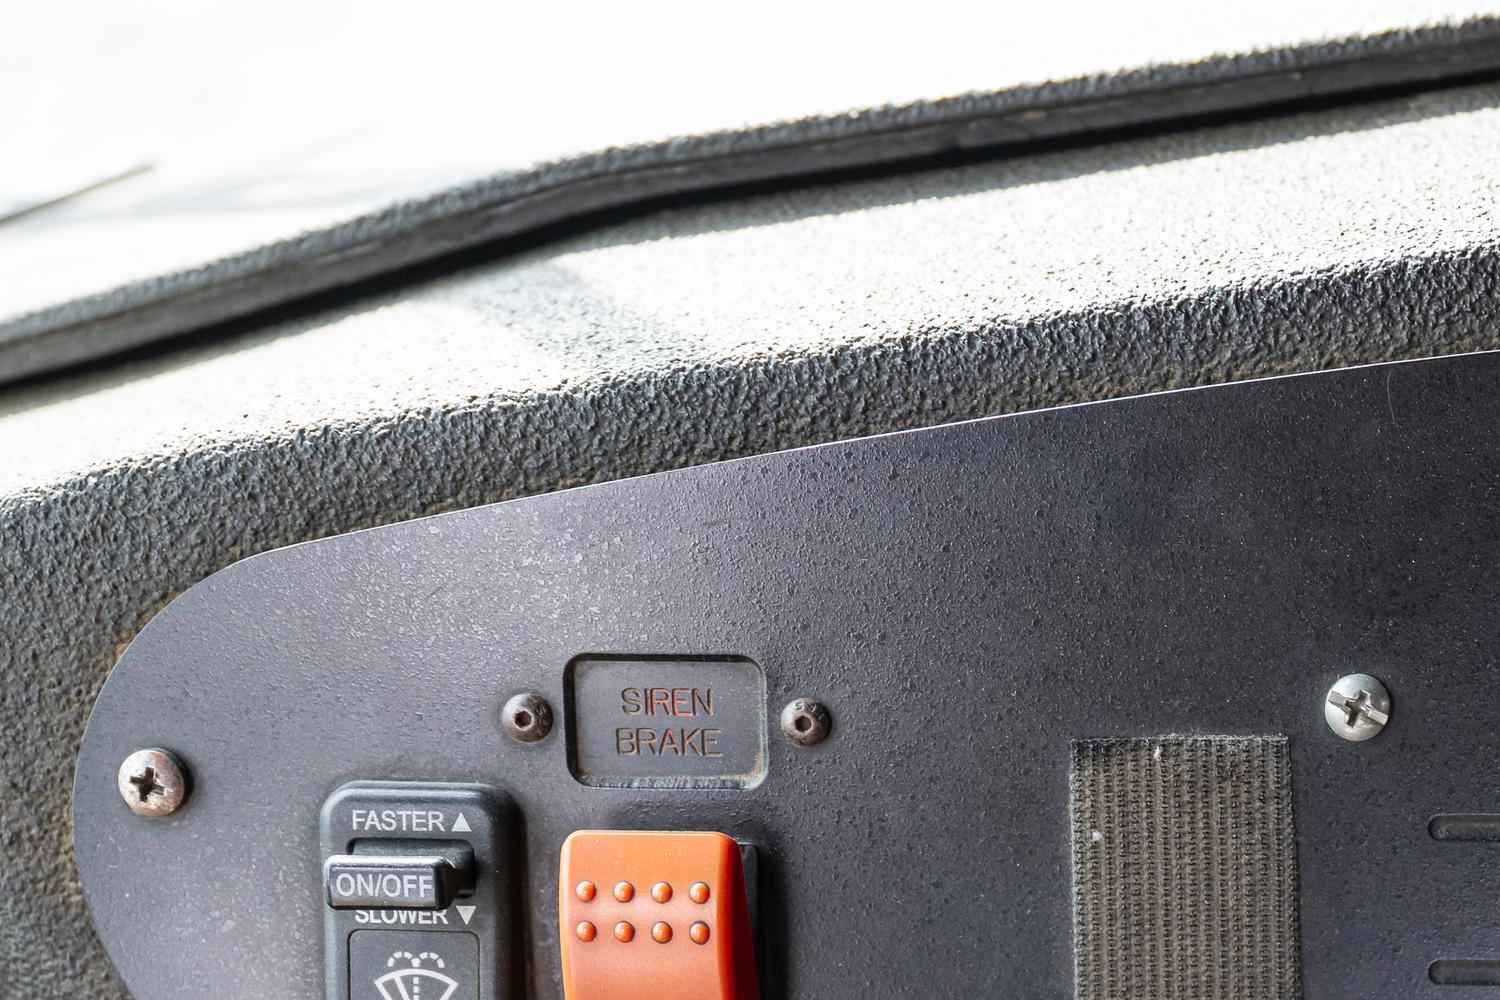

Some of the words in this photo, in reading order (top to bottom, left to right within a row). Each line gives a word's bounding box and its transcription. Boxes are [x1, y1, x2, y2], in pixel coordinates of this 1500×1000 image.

[621, 687, 713, 716] SIREN
[616, 728, 722, 757] BRAKE
[351, 810, 444, 832] FASTER
[336, 873, 433, 898] ON/OFF
[354, 909, 449, 925] SLOWER
